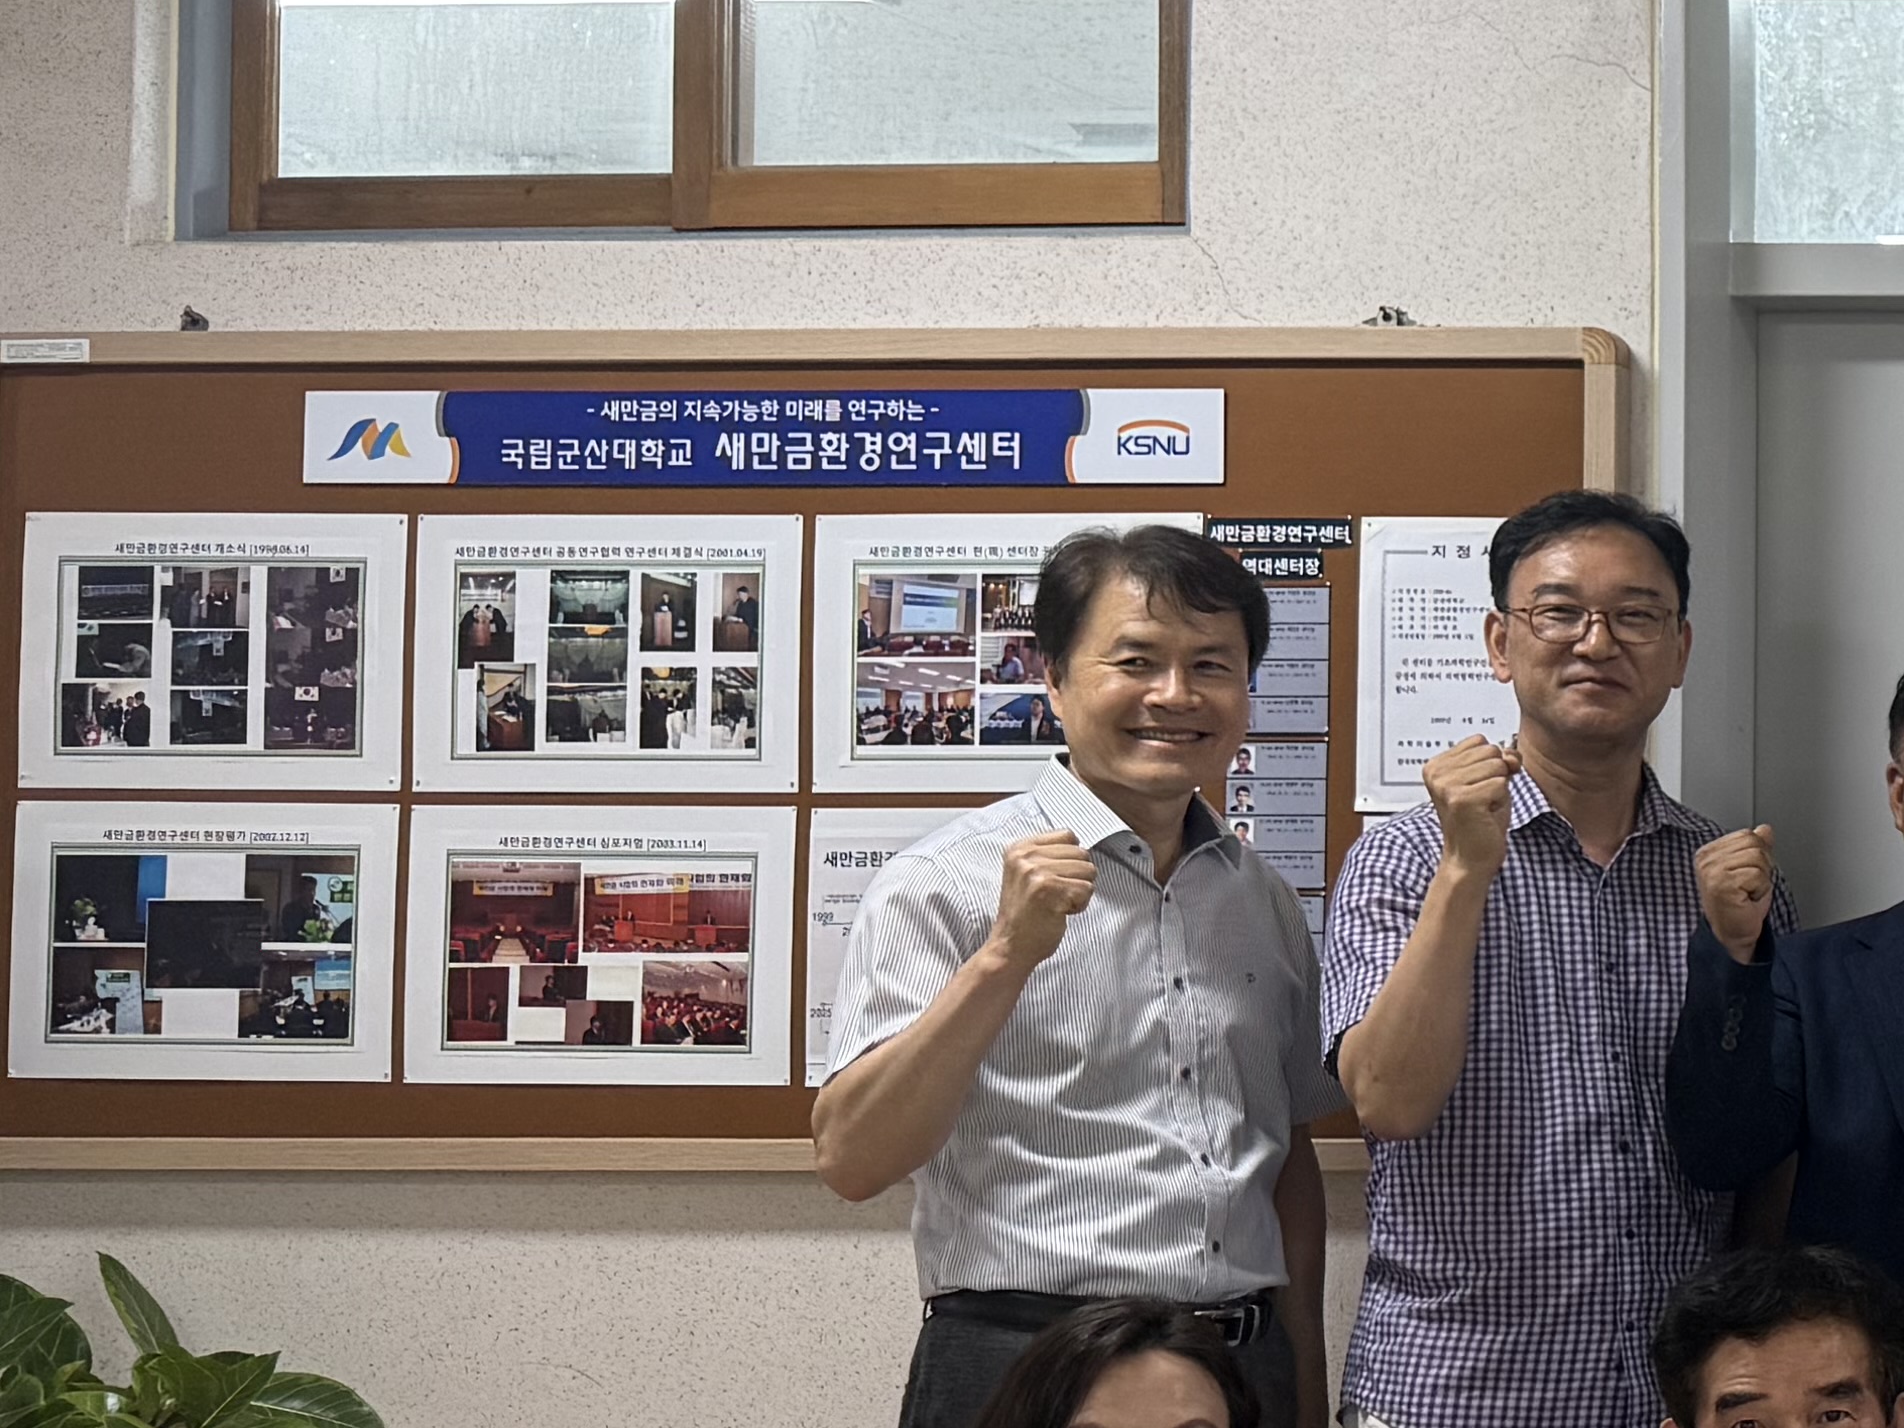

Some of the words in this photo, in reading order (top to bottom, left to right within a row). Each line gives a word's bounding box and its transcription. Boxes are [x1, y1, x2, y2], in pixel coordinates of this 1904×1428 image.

[601, 400, 677, 422] 새만금의
[684, 400, 779, 422] 지속가능한
[785, 399, 843, 422] 미래를
[848, 399, 926, 422] 연구하는
[501, 438, 693, 471] 국립군산대학교
[715, 430, 1021, 472] 새만금환경연구센터
[1117, 434, 1190, 456] KSNU
[1210, 524, 1350, 543] 새만금환경연구센터
[1242, 557, 1320, 575] 역대센터장
